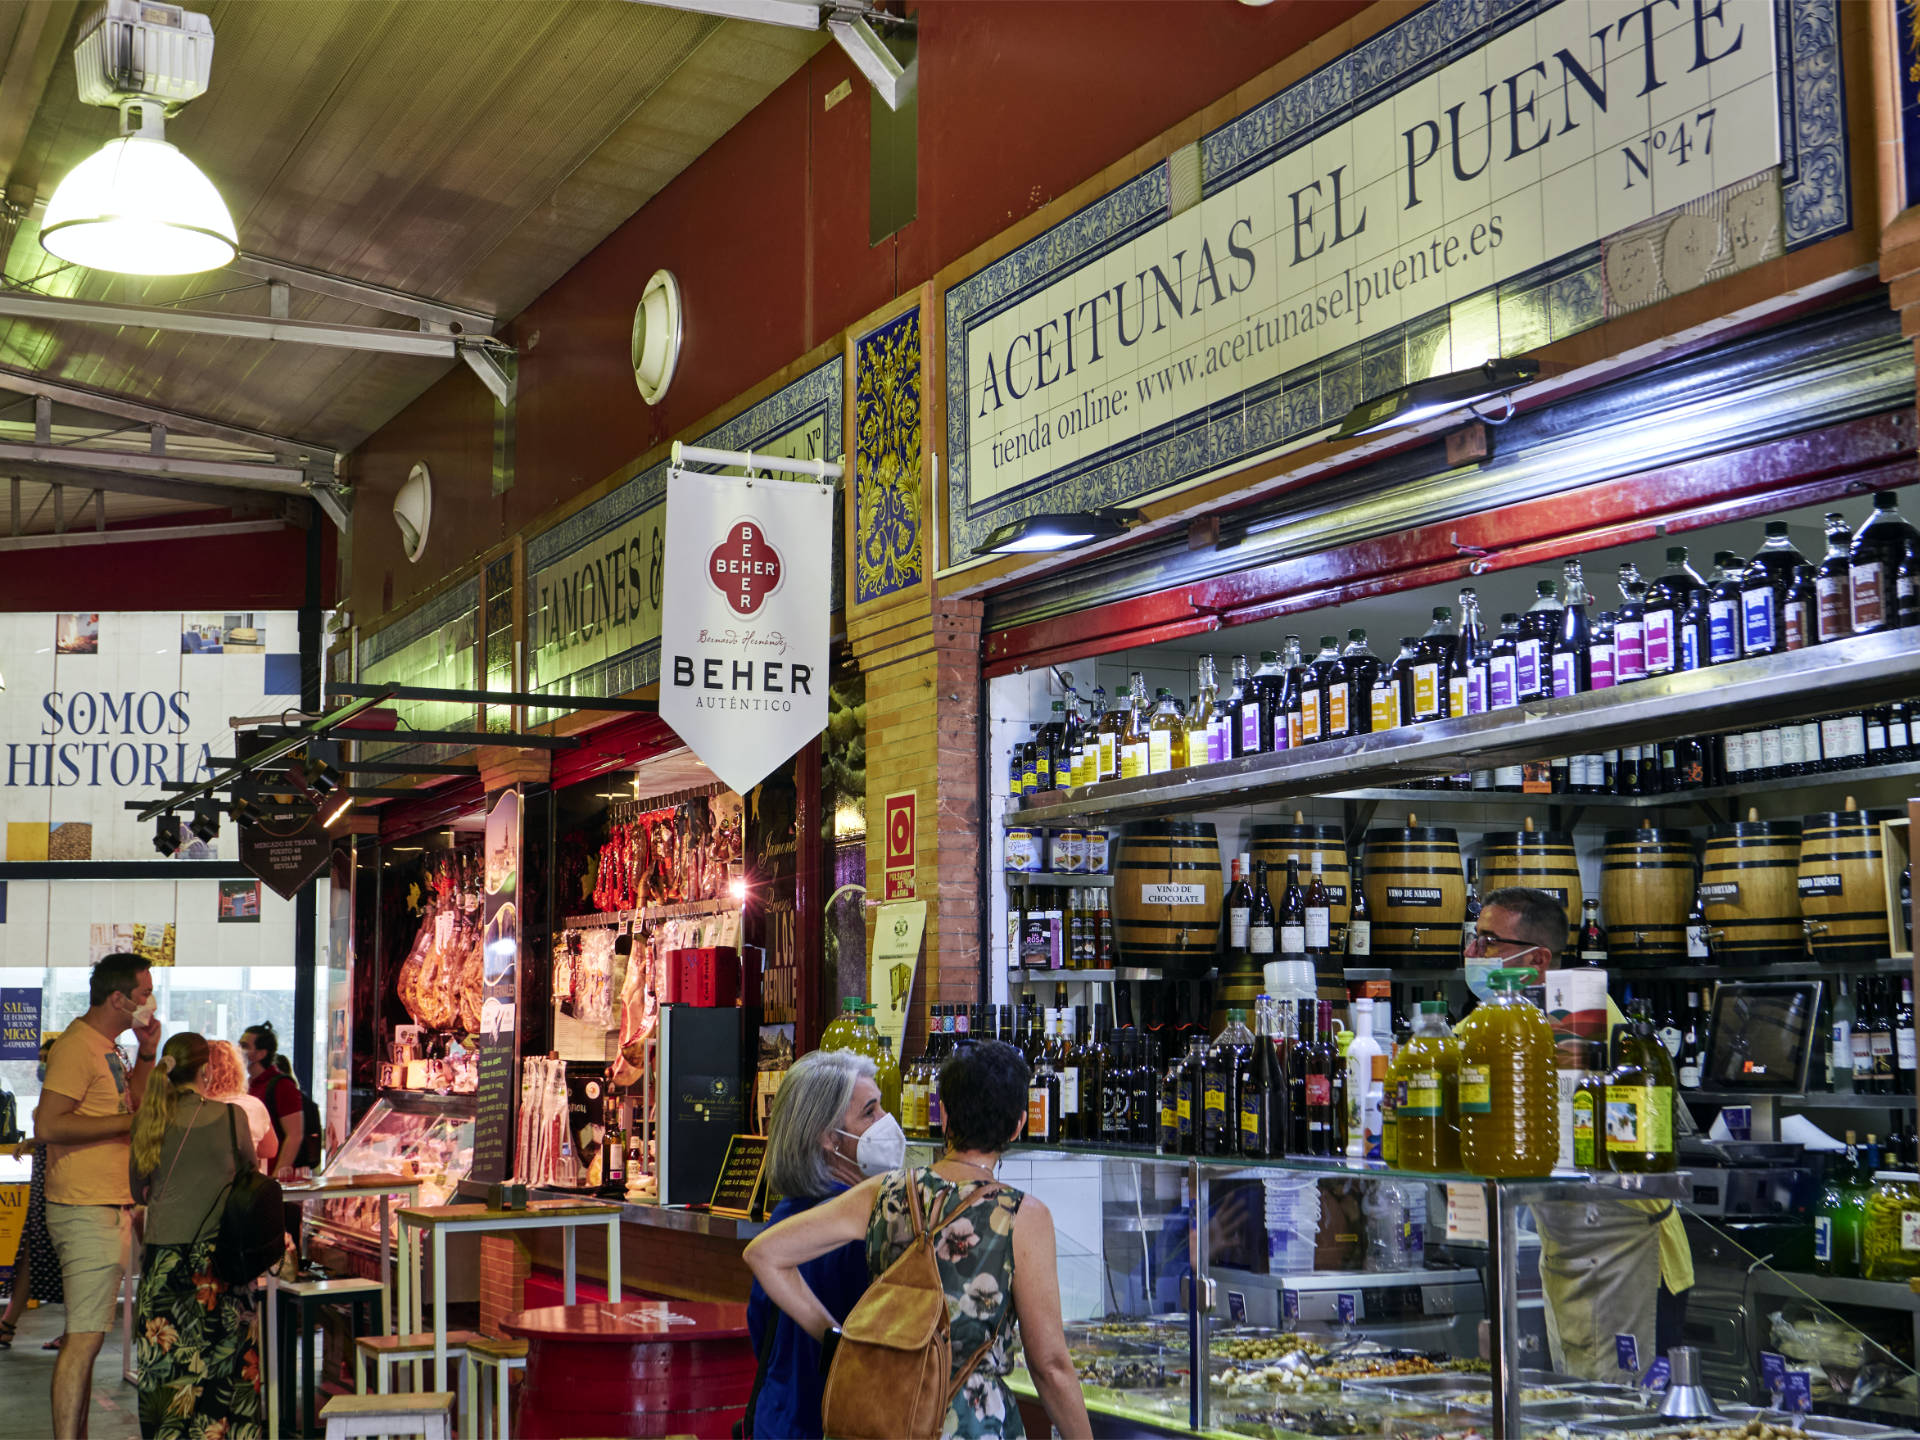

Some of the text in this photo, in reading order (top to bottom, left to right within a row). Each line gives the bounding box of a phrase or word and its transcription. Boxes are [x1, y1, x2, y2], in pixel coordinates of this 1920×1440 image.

[977, 0, 1744, 419] ACEITUNAS EL PUENTE
[991, 214, 1504, 470] tienda online: www.aceitunaselpuente.es
[716, 559, 776, 577] BEHER
[740, 526, 754, 608] BEHER
[541, 530, 641, 657] JAMONES
[673, 655, 813, 695] BEHER
[41, 690, 191, 735] SOMOS
[695, 695, 792, 712] AUTÉNTICO
[4, 742, 219, 787] HISTORIA
[1148, 895, 1200, 903] CHOCOLATE
[1156, 885, 1192, 894] VINO DE
[1388, 889, 1440, 899] VINO DE NARANJA
[775, 909, 795, 967] LOS
[1026, 936, 1045, 944] ROSA
[3, 1028, 37, 1040] MIGAS
